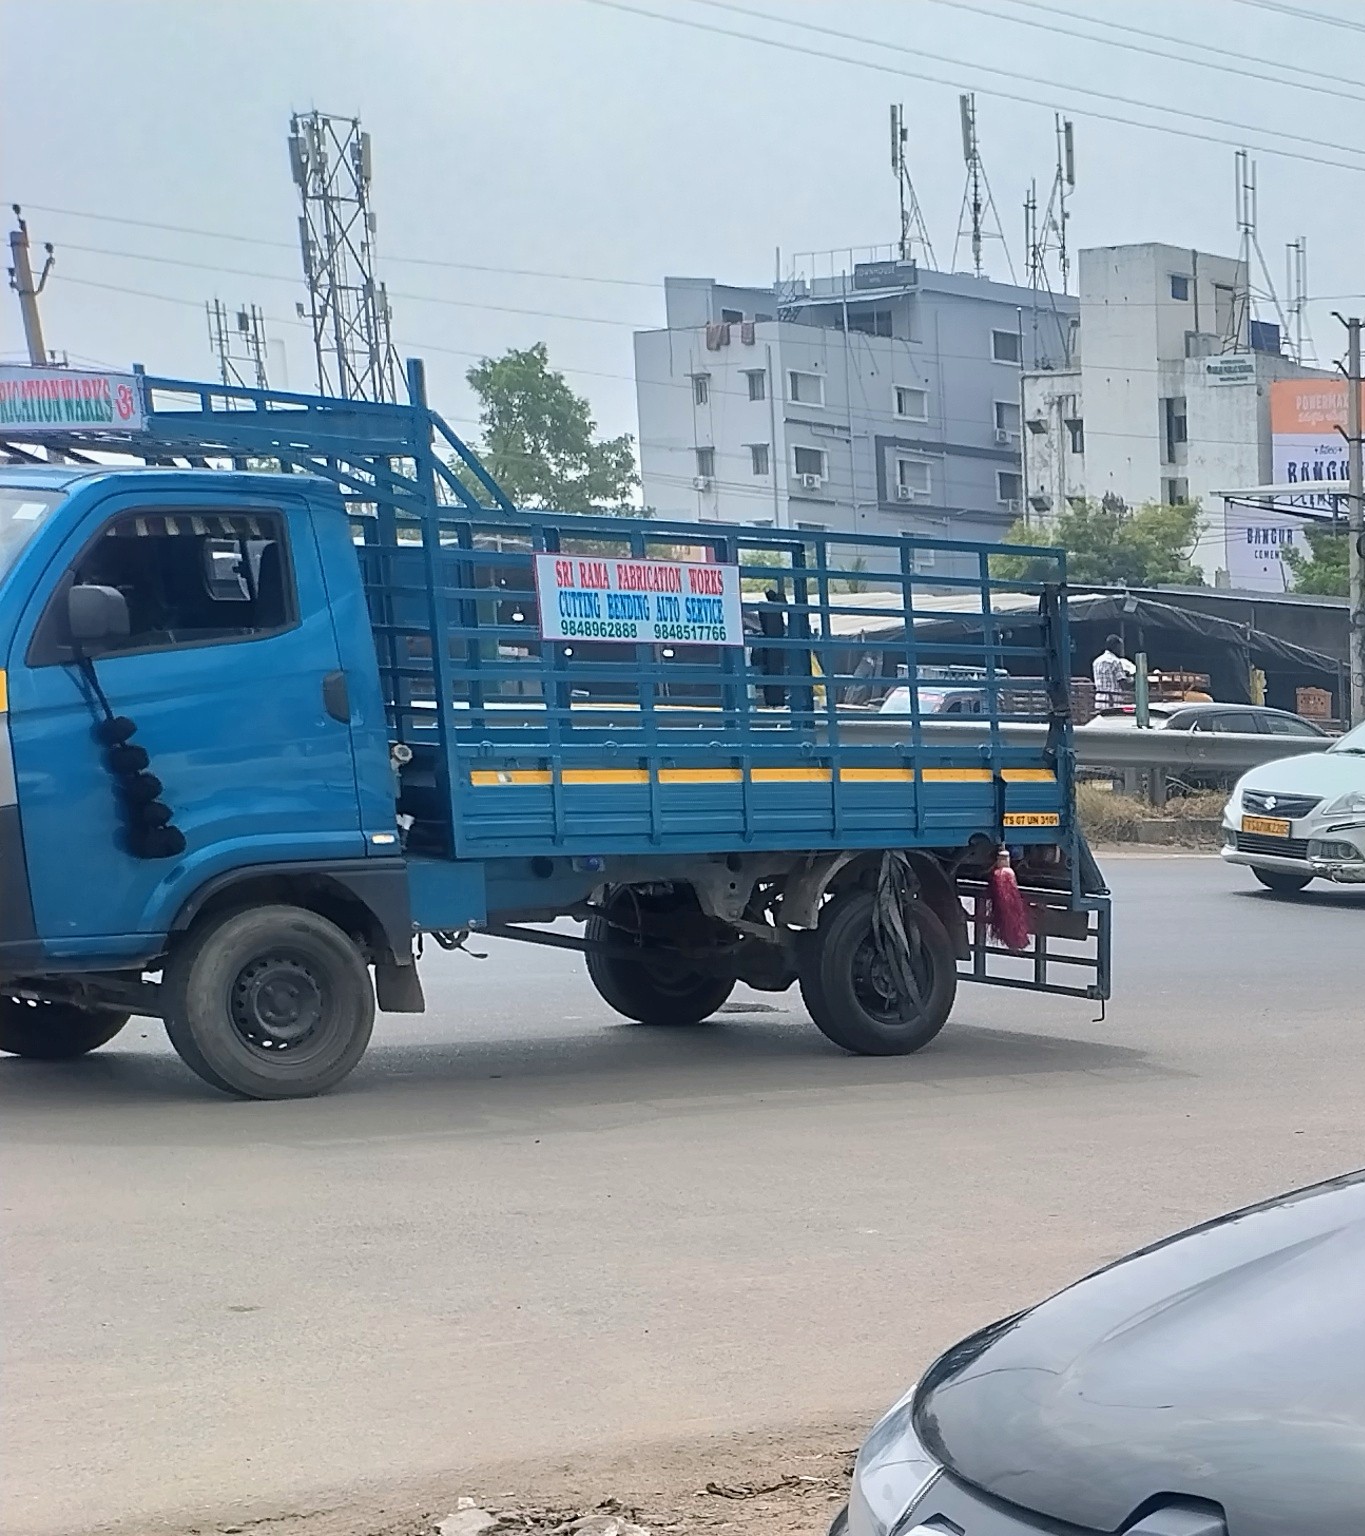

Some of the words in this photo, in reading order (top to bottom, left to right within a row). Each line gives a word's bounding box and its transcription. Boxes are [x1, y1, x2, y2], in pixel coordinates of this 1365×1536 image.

[1296, 394, 1349, 410] POWERMAX
[1288, 460, 1351, 483] BANGU
[1247, 528, 1293, 545] BANGUR
[1254, 550, 1281, 559] CEMEN
[555, 560, 574, 588] SRI
[579, 562, 610, 590] RAMA
[616, 564, 683, 593] FABRICATION
[688, 568, 725, 596] WORKS
[559, 590, 601, 618] CUTTING
[606, 593, 650, 622] BENDING
[656, 596, 681, 622] AUTO
[685, 597, 725, 625] SERVICE
[654, 623, 727, 641] 9848517766
